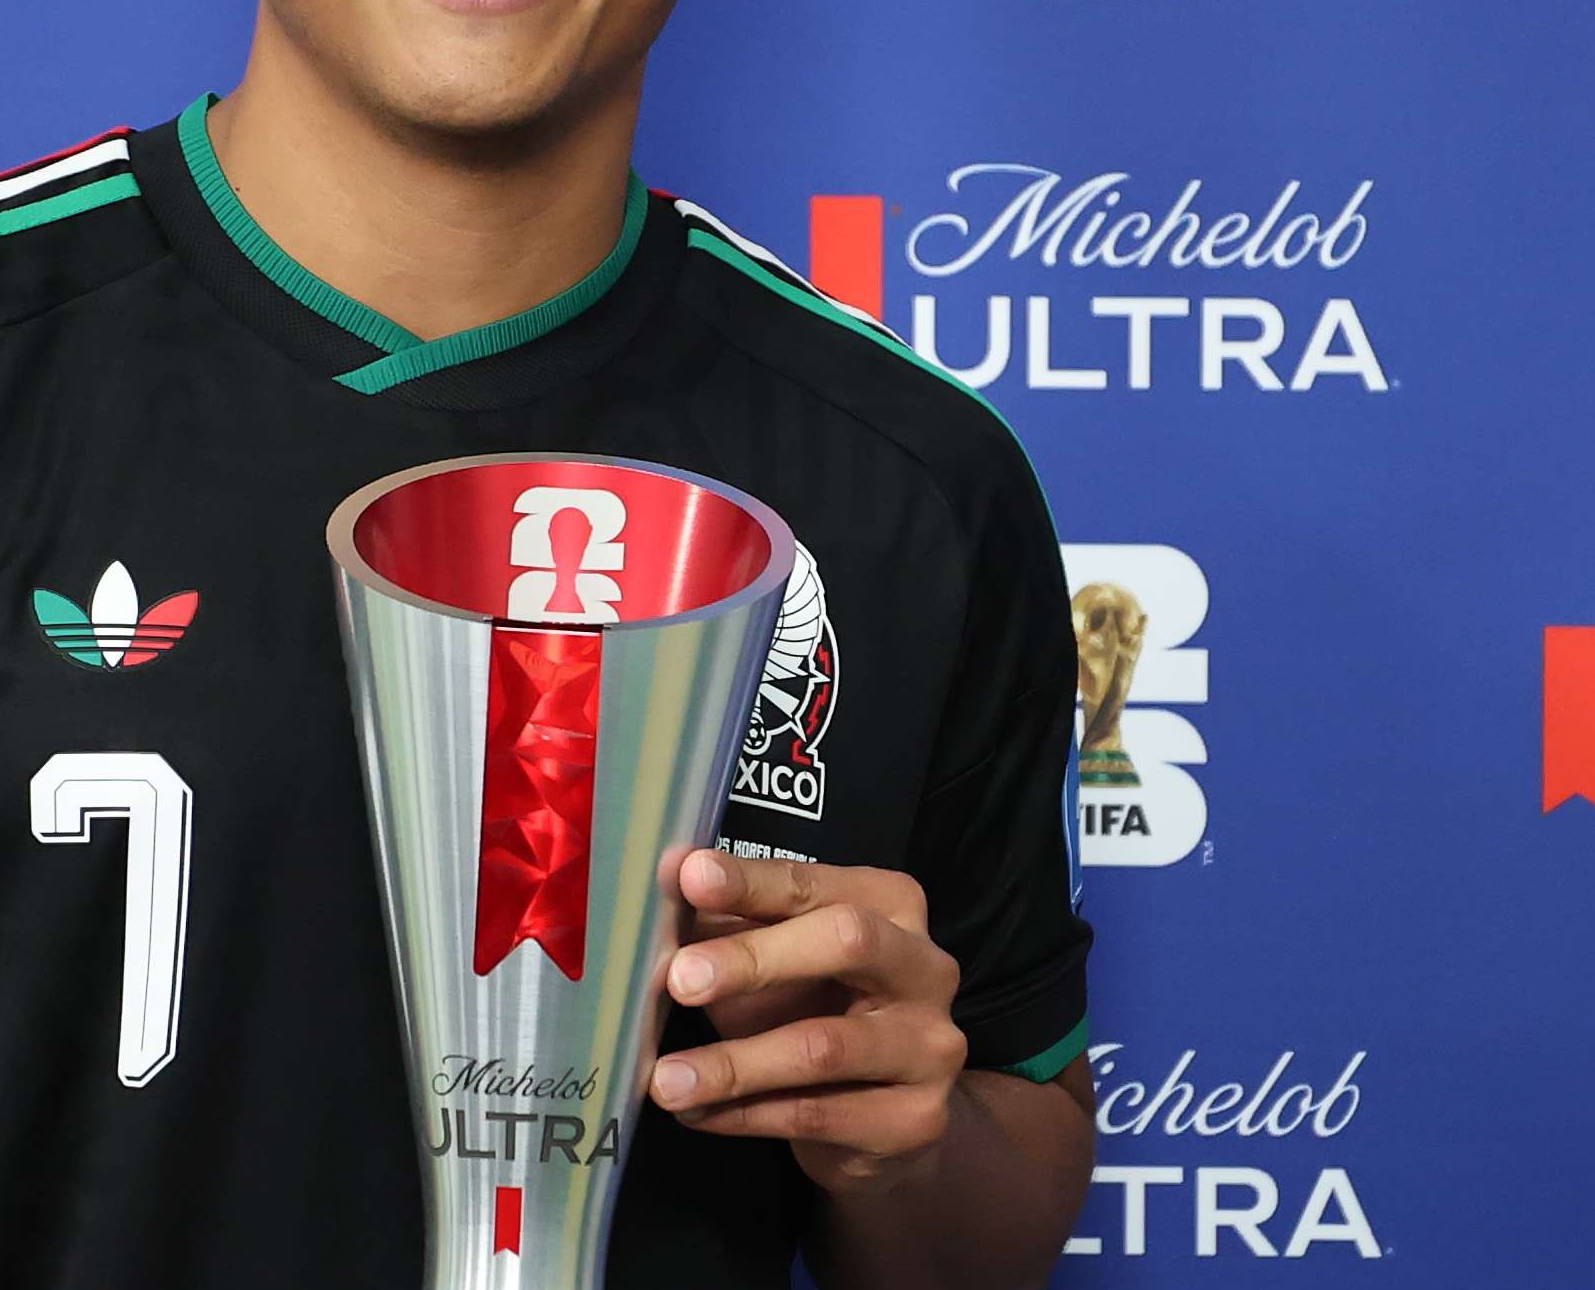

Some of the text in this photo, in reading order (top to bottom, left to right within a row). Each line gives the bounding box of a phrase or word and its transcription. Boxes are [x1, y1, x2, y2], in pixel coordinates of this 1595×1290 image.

[905, 163, 1374, 277] Michelob
[908, 294, 1389, 392] ULTRA
[735, 757, 818, 806] XICO
[1080, 804, 1150, 838] IFA
[29, 752, 194, 1089] 7
[432, 1054, 598, 1102] Michelob
[1088, 1043, 1365, 1137] chelob
[1062, 1166, 1381, 1257] TRA
